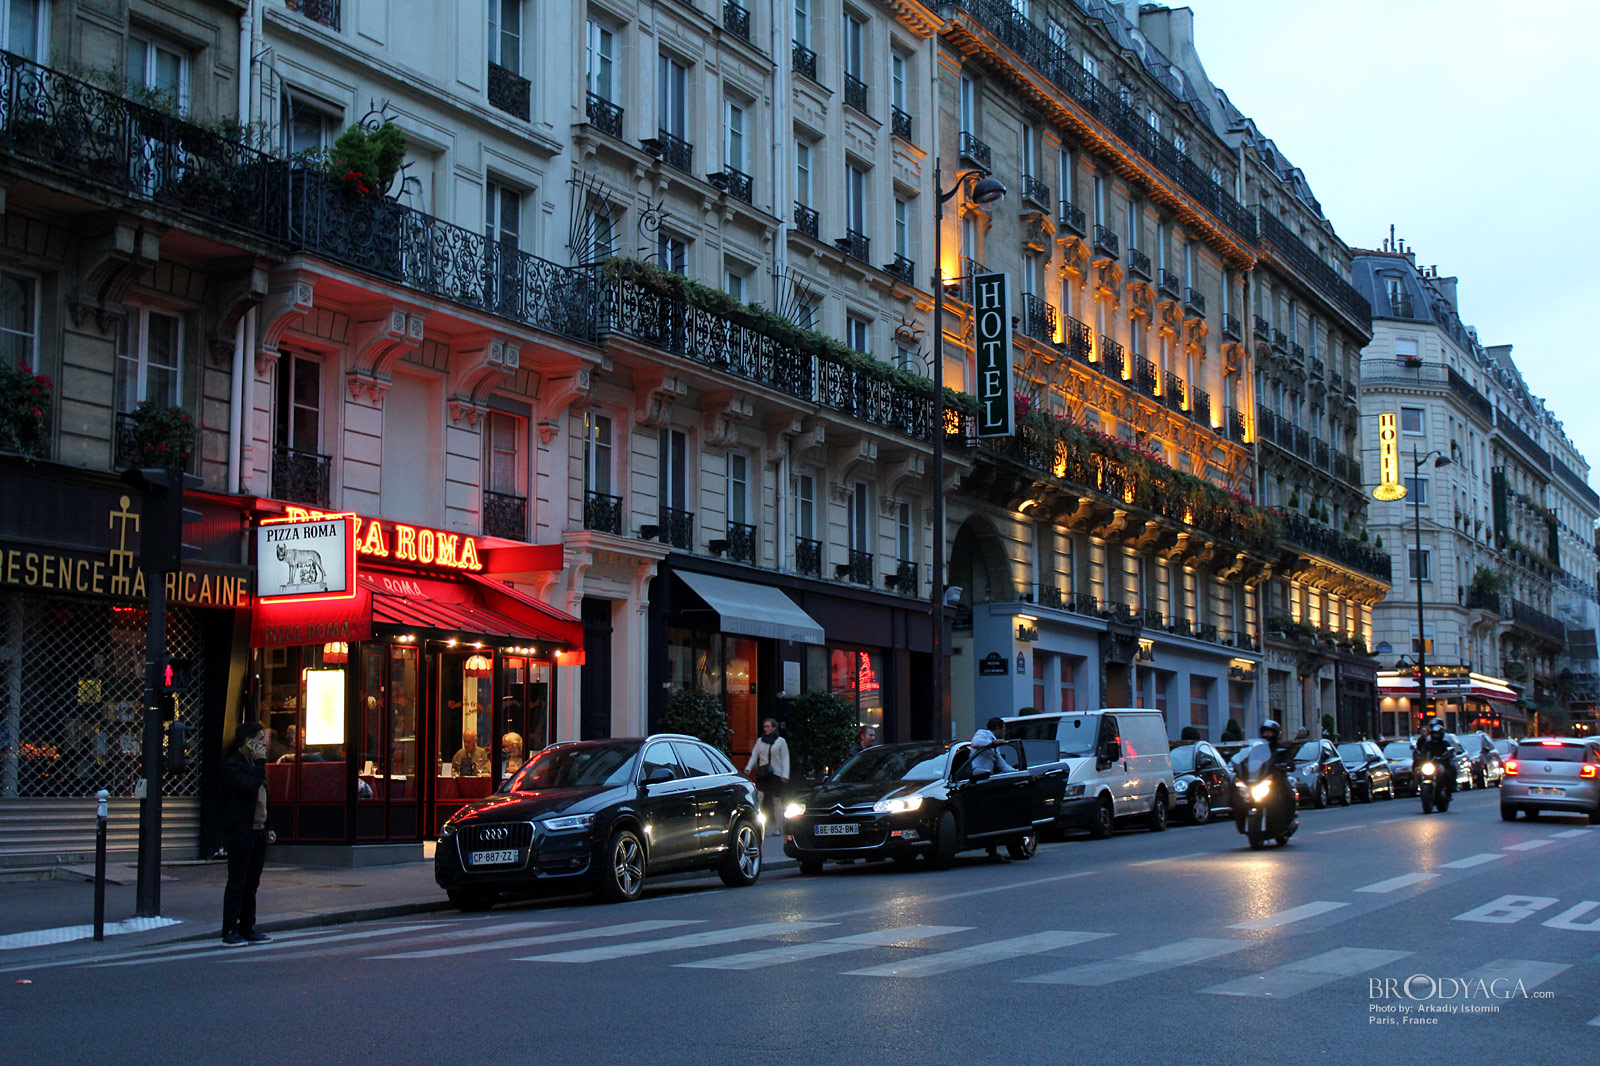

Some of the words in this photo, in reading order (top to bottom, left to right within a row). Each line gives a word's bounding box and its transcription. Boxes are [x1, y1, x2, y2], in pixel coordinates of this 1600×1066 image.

[979, 281, 1003, 428] HOTEL
[1381, 414, 1395, 483] HOTEL
[266, 528, 300, 542] PIZZA
[303, 524, 337, 539] ROMA
[394, 524, 482, 570] ROMA
[132, 566, 247, 606] ARICAINE
[382, 577, 427, 597] ROMA
[265, 624, 301, 644] PIZZA
[307, 621, 351, 639] ROMA
[473, 851, 513, 863] CP-887-ZZ
